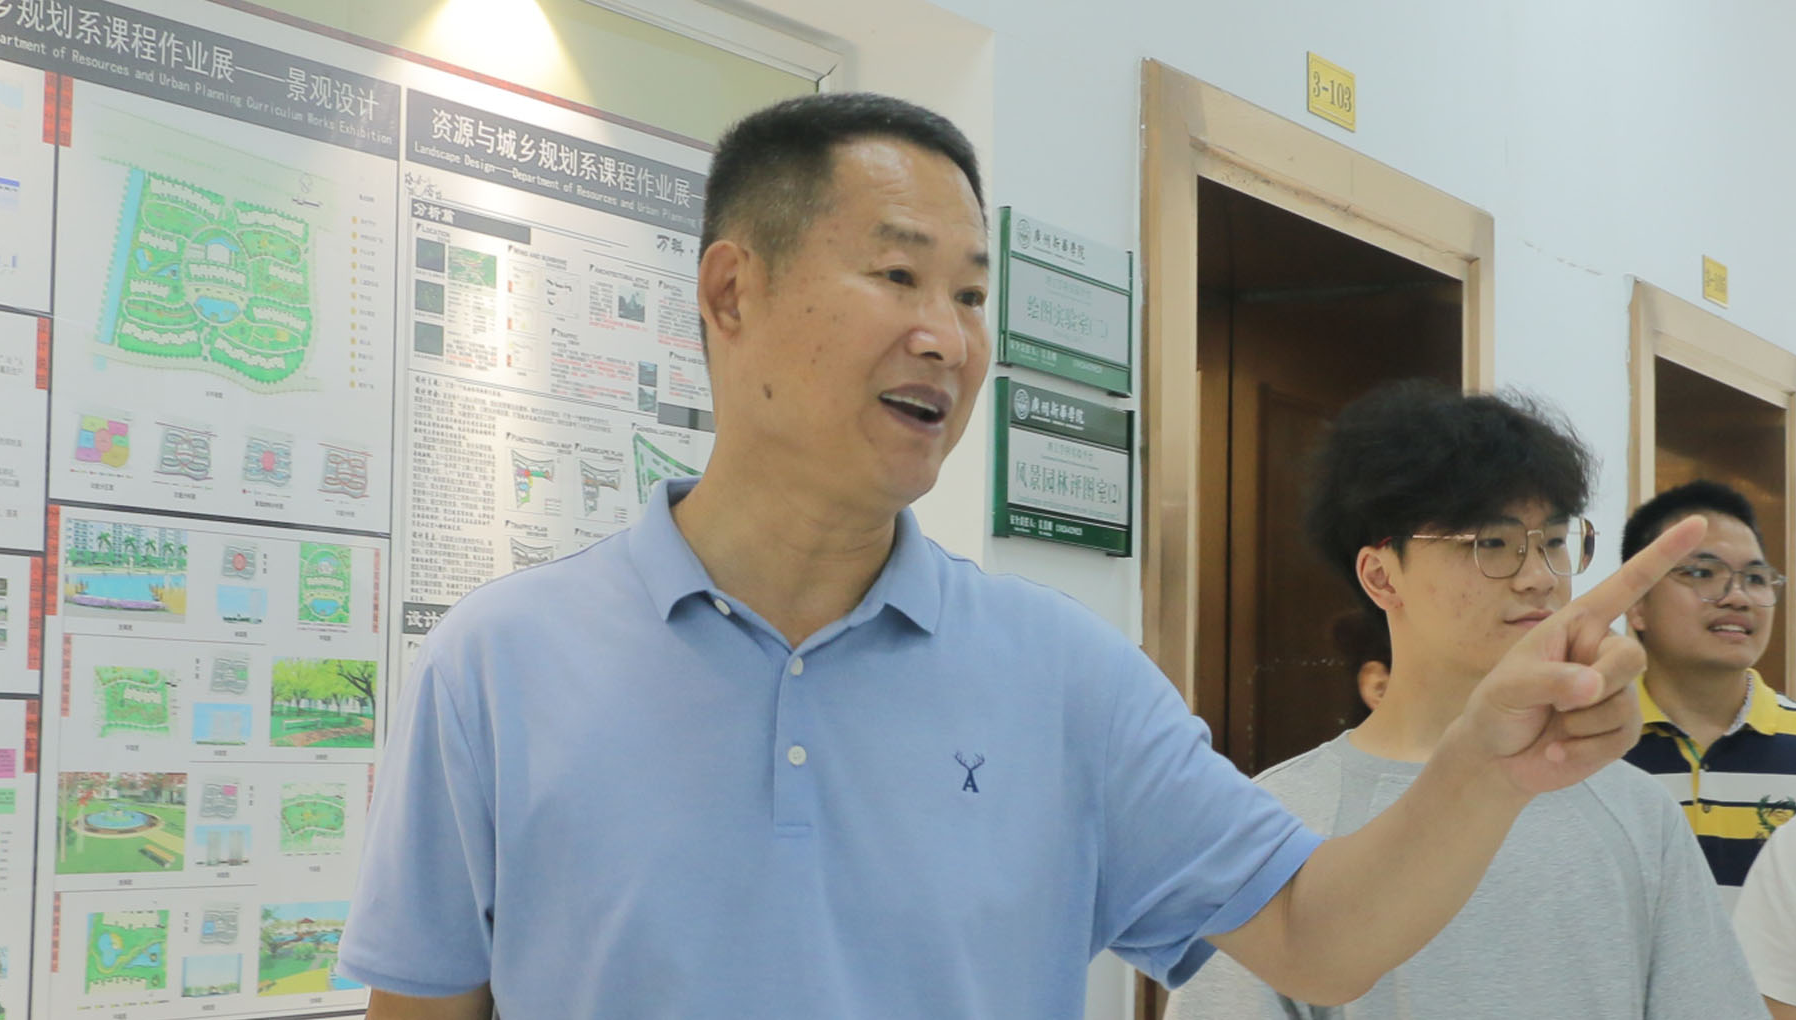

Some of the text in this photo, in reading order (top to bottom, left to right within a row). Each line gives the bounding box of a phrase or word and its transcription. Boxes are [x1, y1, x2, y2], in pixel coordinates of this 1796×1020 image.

[53, 41, 66, 59] of
[72, 49, 130, 77] Resources
[135, 67, 154, 83] and
[159, 74, 191, 92] Urban
[195, 83, 243, 108] Planning
[246, 96, 303, 121] Curriculum
[339, 120, 393, 145] Exhibition
[1313, 71, 1352, 113] 3-103
[414, 140, 461, 163] Landscape
[563, 182, 574, 193] of
[576, 184, 617, 205] Resources
[621, 199, 635, 210] and
[405, 610, 445, 631] 设计
